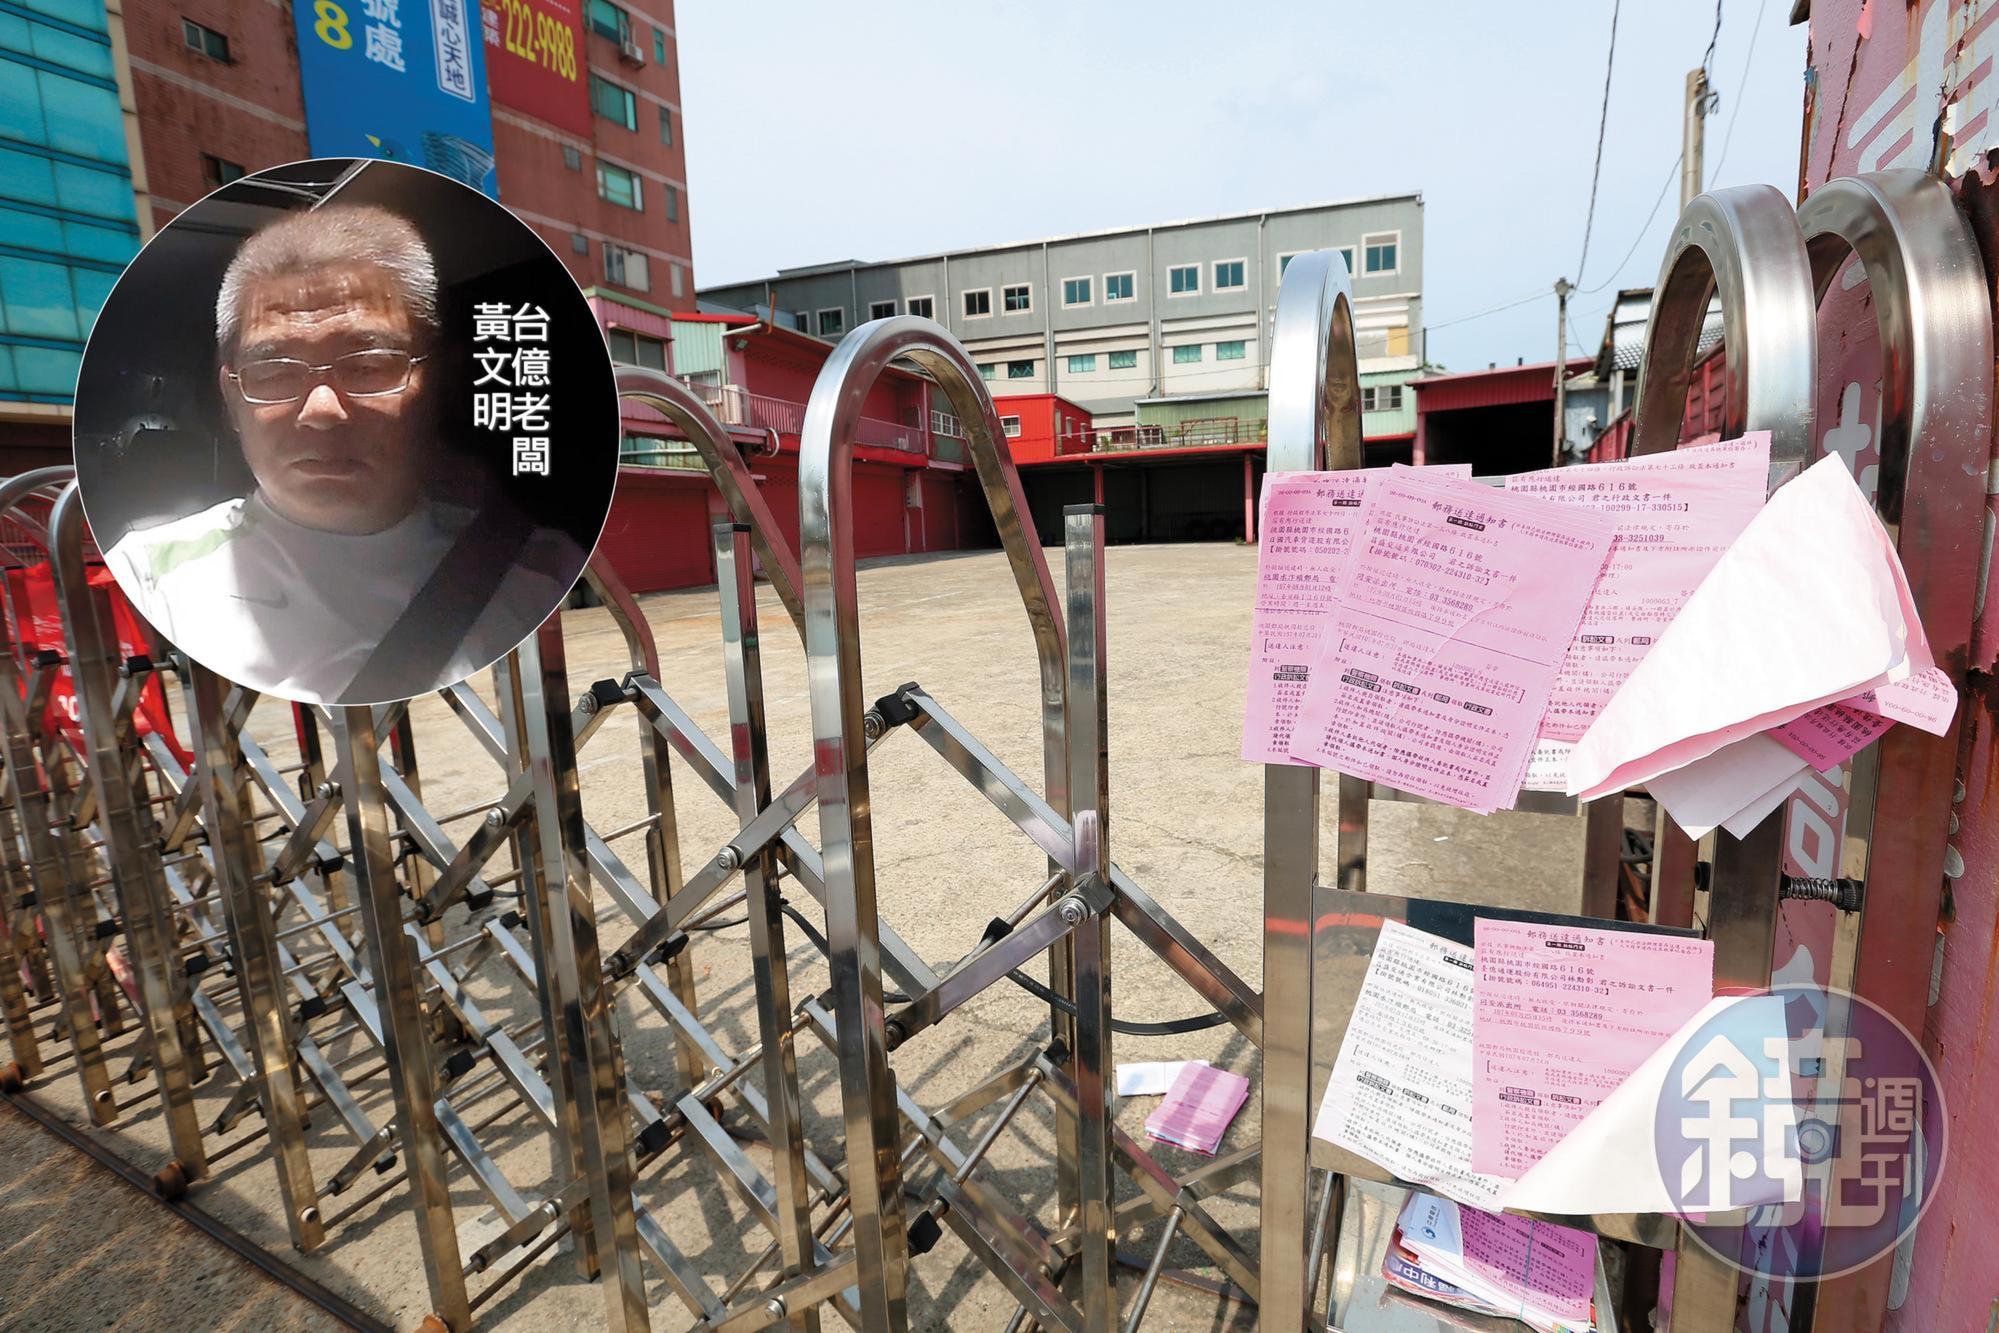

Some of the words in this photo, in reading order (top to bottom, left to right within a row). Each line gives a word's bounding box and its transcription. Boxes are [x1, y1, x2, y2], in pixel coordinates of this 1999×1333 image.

[314, 0, 352, 50] 8
[1432, 501, 1508, 528] 郵務送達通知書
[1526, 929, 1606, 948] 郵務送達通知書
